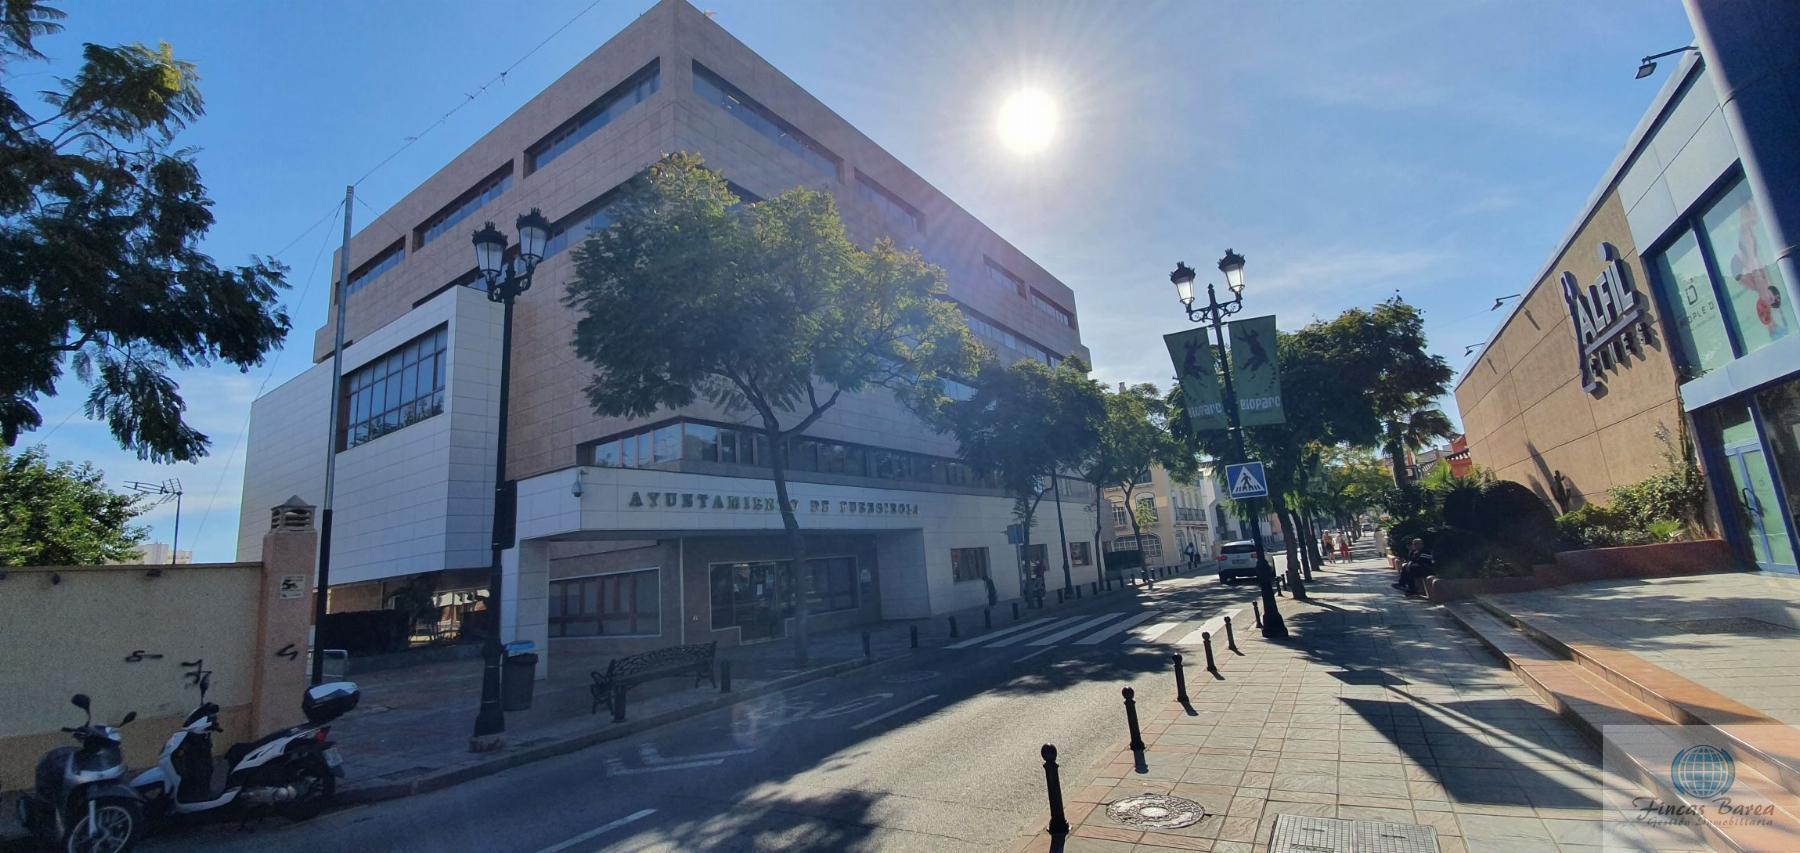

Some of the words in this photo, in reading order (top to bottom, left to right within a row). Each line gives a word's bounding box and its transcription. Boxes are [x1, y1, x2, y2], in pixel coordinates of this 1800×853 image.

[1576, 259, 1634, 345] ALFIL
[628, 491, 799, 511] AYUNTAMIENO
[809, 500, 830, 513] DE
